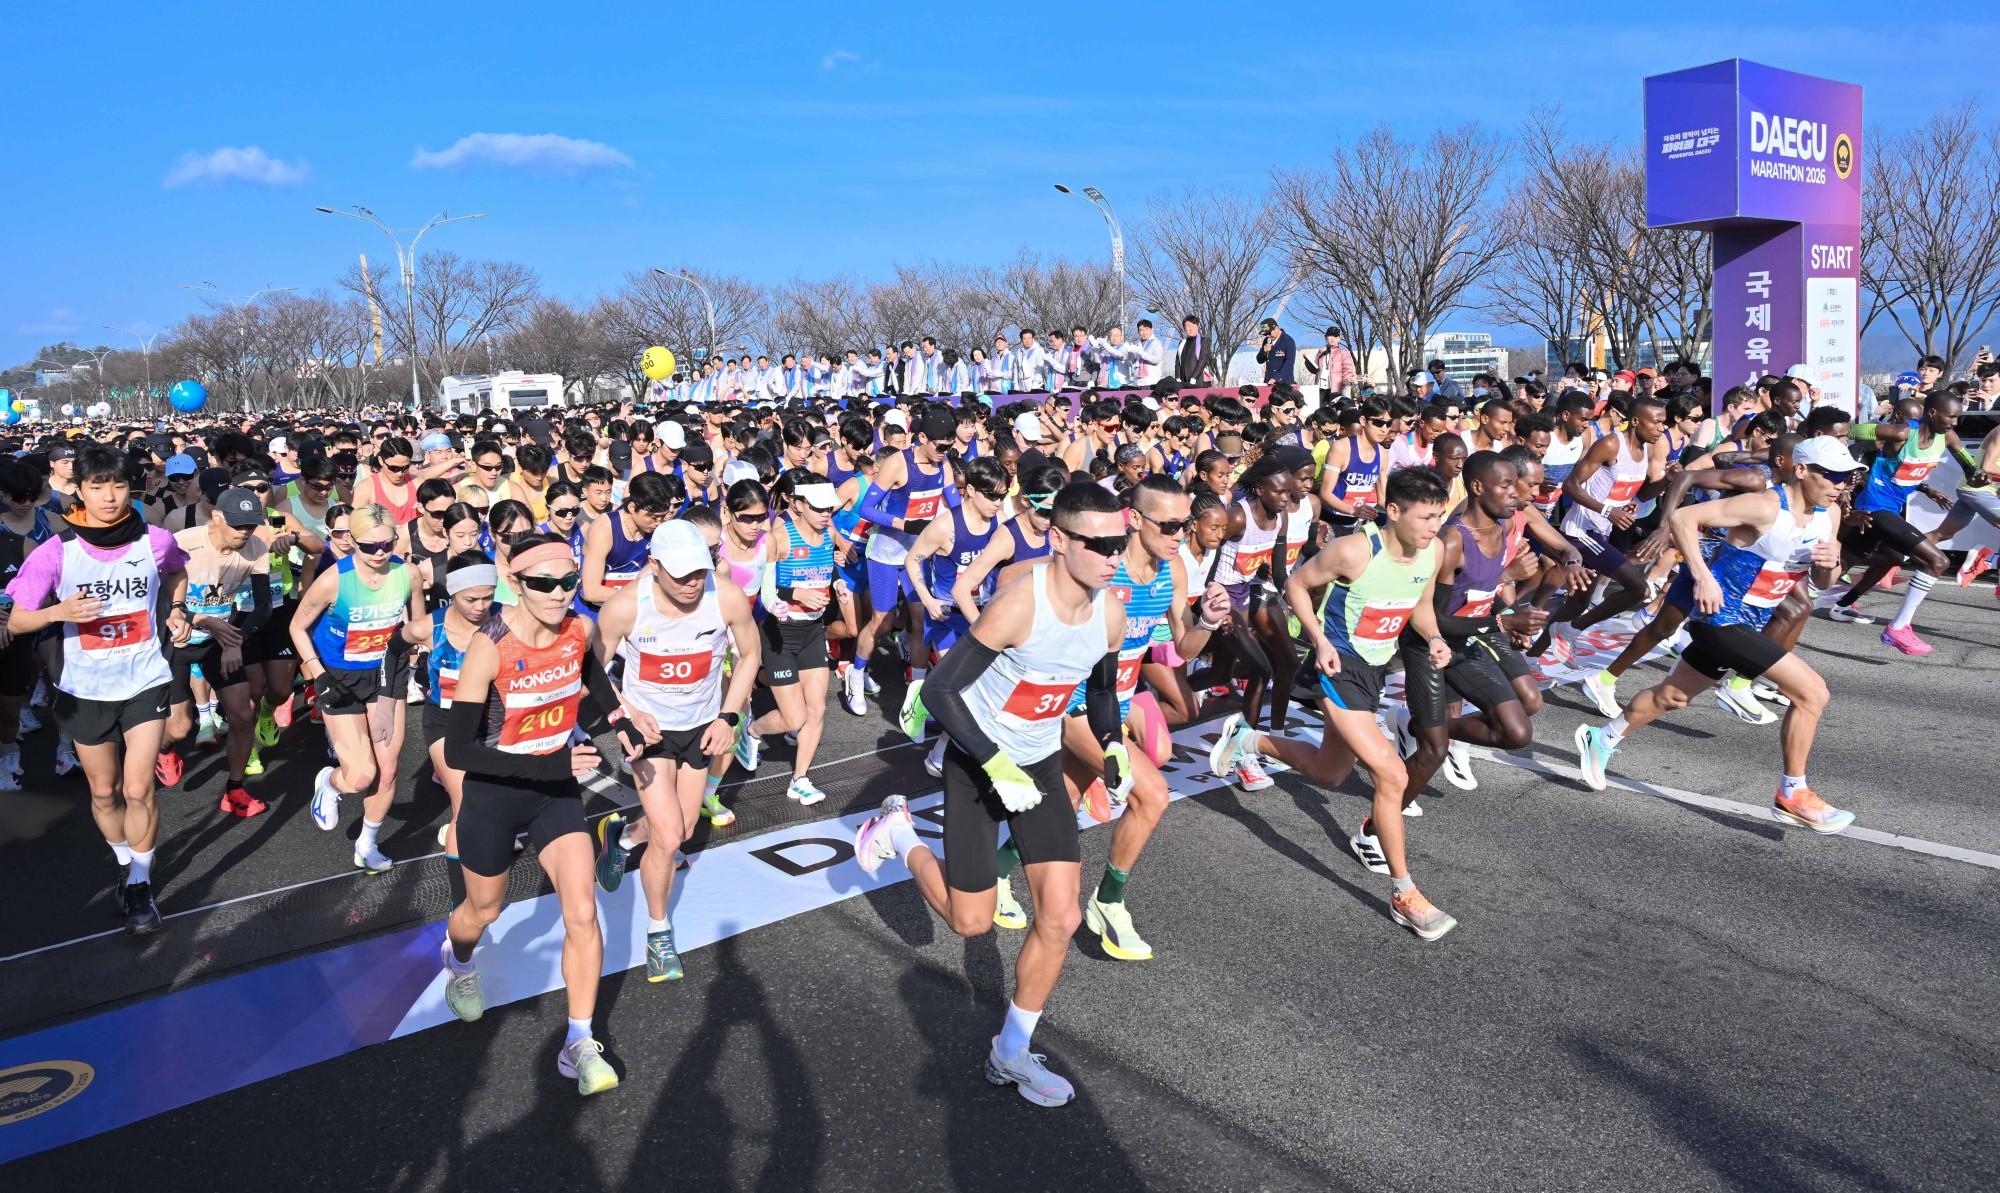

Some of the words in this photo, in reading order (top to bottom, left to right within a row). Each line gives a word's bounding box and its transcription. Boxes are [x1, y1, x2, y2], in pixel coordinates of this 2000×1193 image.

[1661, 139, 1695, 153] 파워풀
[1696, 134, 1720, 148] 대구
[1750, 110, 1827, 162] DAEGU
[1751, 159, 1804, 182] MARATHON
[1805, 166, 1826, 184] 2026
[1811, 244, 1854, 270] START
[1908, 467, 1927, 477] 40
[1626, 486, 1633, 497] 1
[918, 501, 934, 514] 23
[1353, 497, 1366, 507] 75
[76, 576, 148, 602] 포항시청
[1769, 579, 1796, 594] 22
[1467, 603, 1492, 617] 32
[100, 622, 128, 641] 91
[1376, 616, 1403, 633] 28
[509, 659, 580, 691] MONGOLIA
[659, 661, 692, 679] 30
[773, 670, 793, 679] HKG
[1034, 693, 1066, 714] 31
[518, 705, 565, 735] 210
